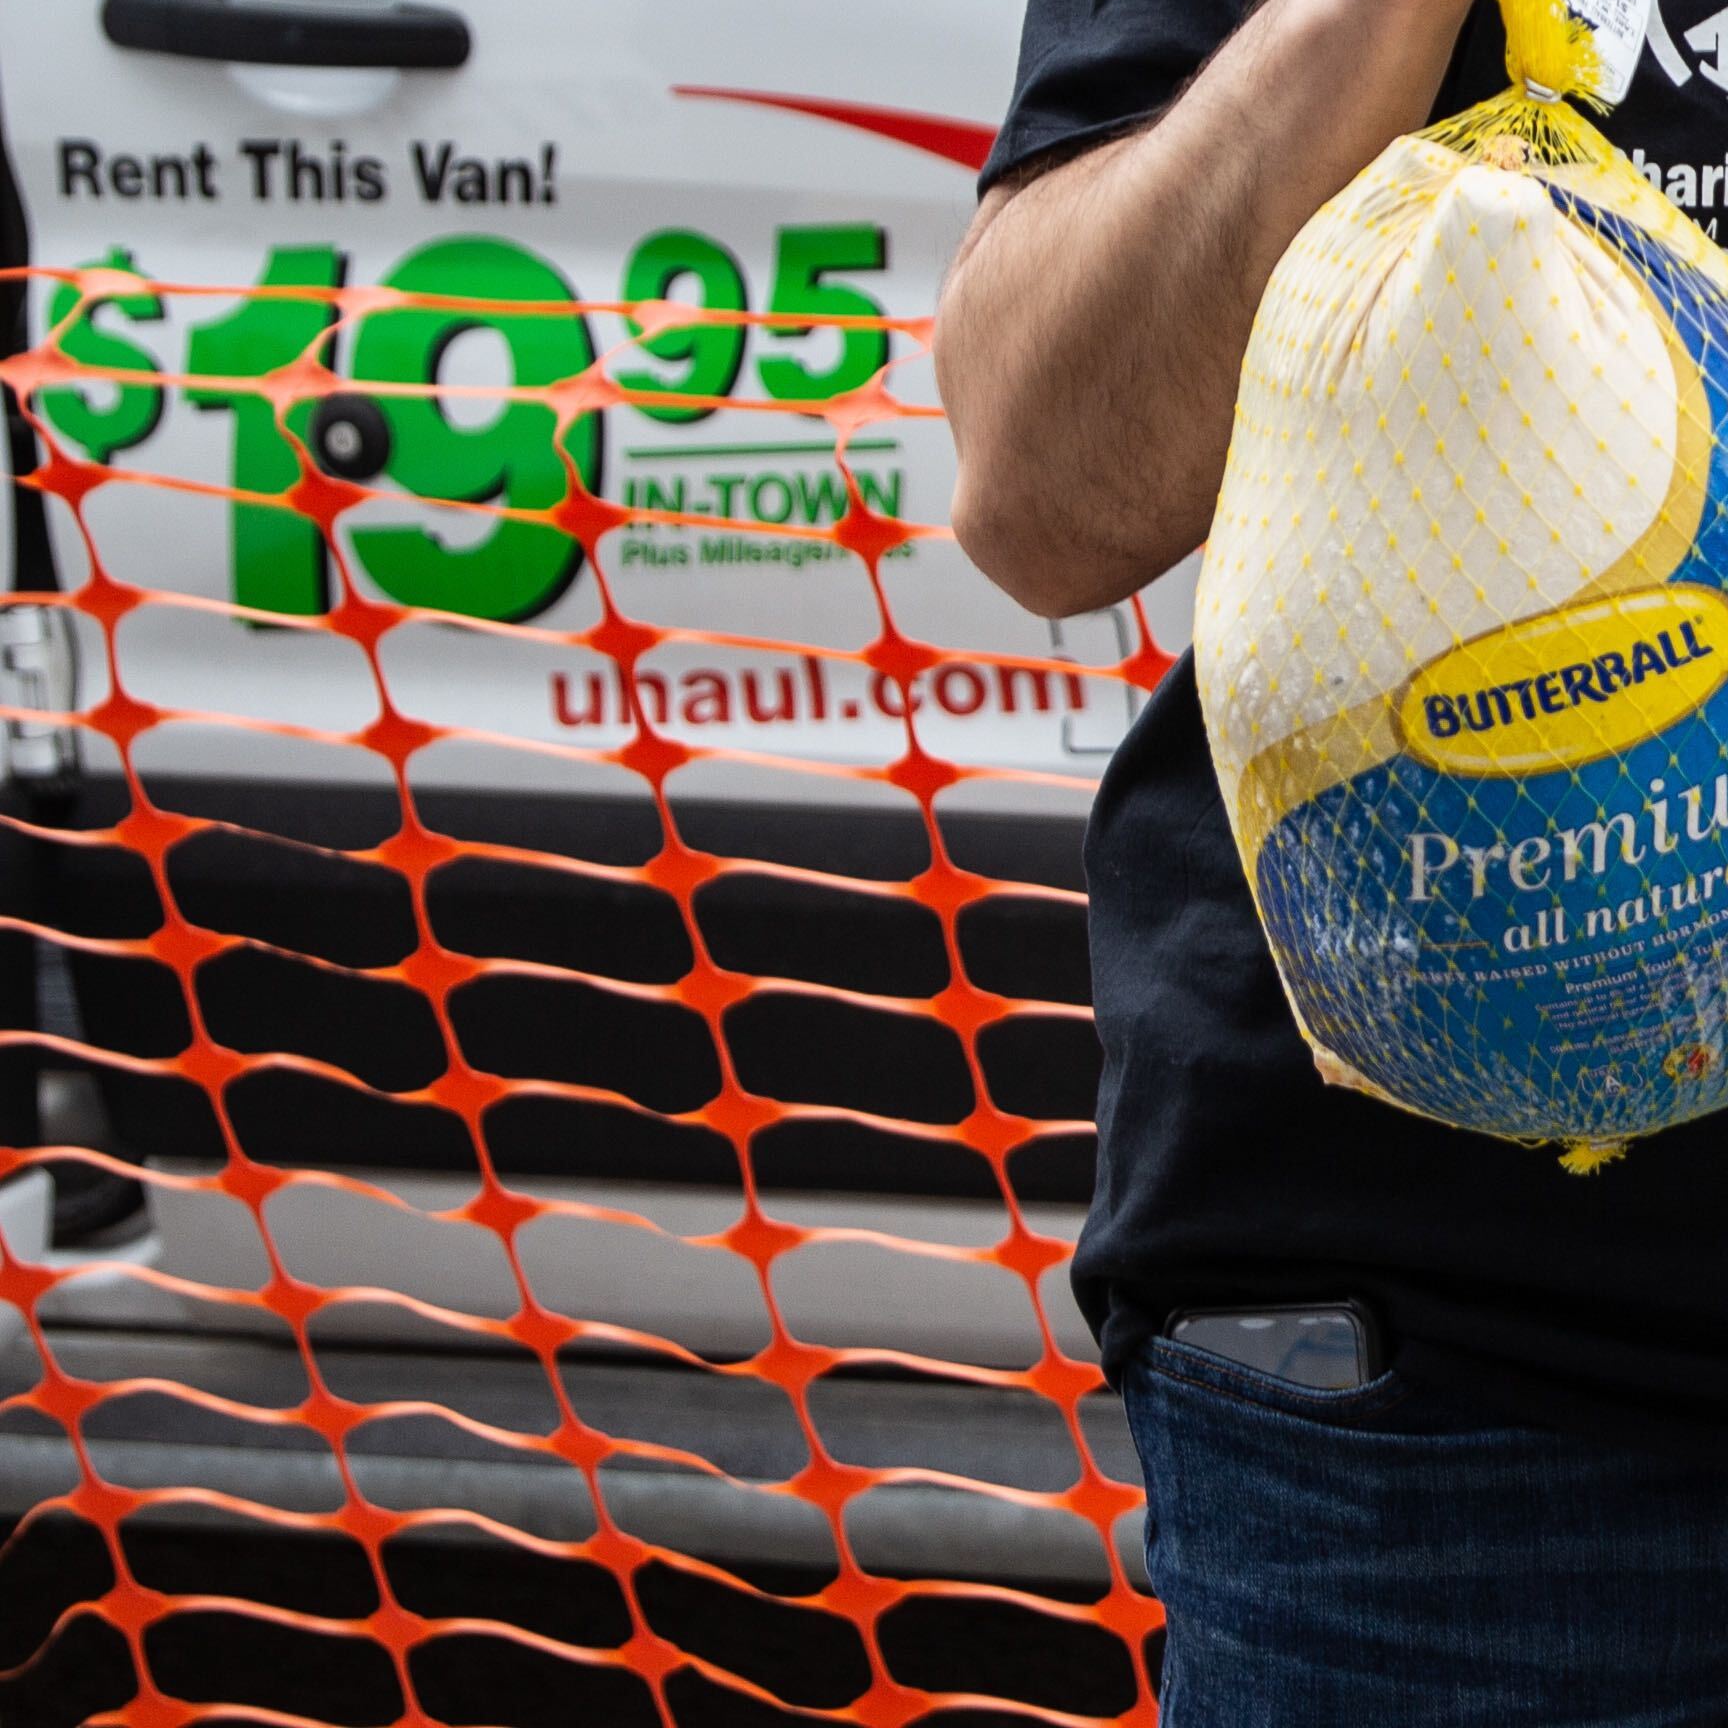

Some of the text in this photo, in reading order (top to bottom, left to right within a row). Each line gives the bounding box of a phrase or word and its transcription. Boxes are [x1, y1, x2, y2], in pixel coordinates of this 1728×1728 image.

[57, 138, 558, 205] Rent This Van!
[624, 468, 903, 529] IN-TOWN
[621, 538, 689, 568] Plus
[550, 653, 1090, 726] uhaul.com
[1423, 619, 1713, 739] BUTTERBALL
[1503, 904, 1569, 953] all
[1475, 963, 1547, 982] RAISED
[1553, 940, 1645, 972] WITHOUT
[1565, 970, 1637, 994] Premium
